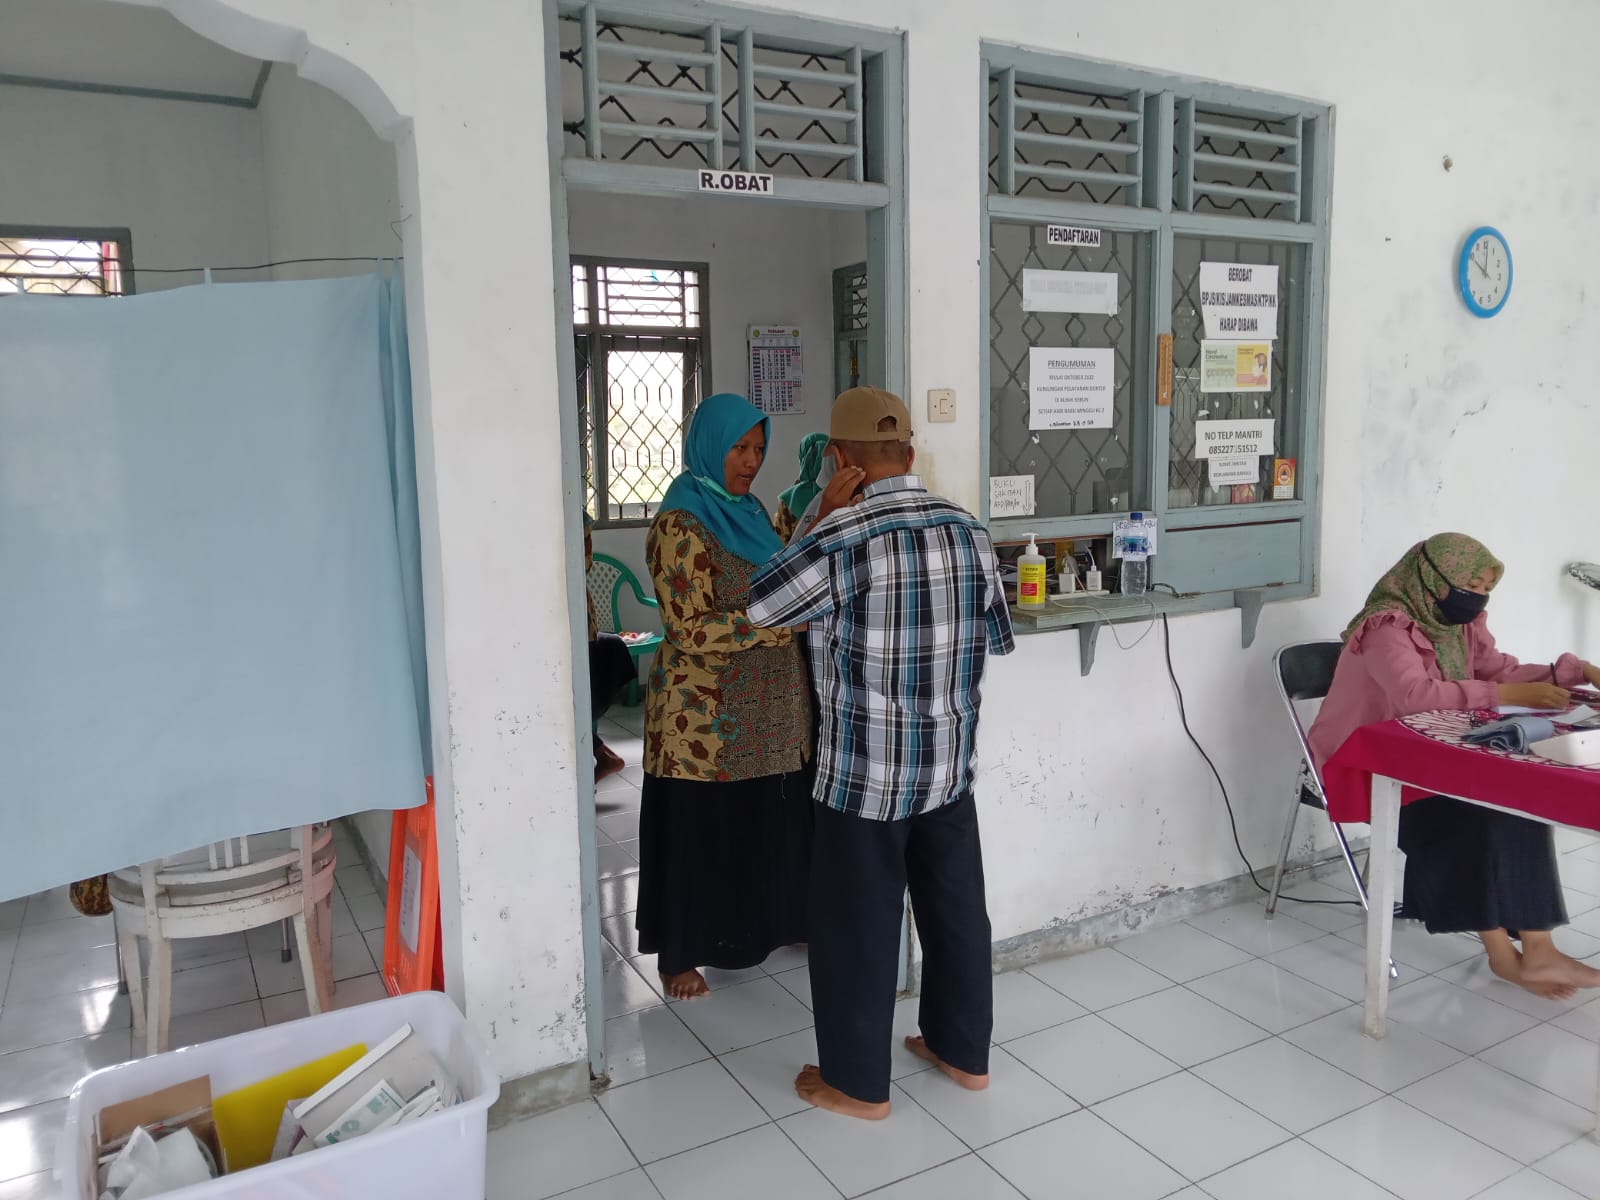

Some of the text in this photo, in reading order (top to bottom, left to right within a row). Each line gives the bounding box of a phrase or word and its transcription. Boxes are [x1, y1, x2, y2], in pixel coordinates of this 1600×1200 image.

[701, 172, 771, 191] R.OBAT
[1049, 227, 1099, 244] PENDAFTARAN
[1228, 267, 1252, 282] BEROBAT
[1219, 317, 1258, 331] HARAP DIBAWA
[1047, 359, 1096, 369] PENGUMUMAN
[1204, 430, 1263, 440] NO TELP MANTRI
